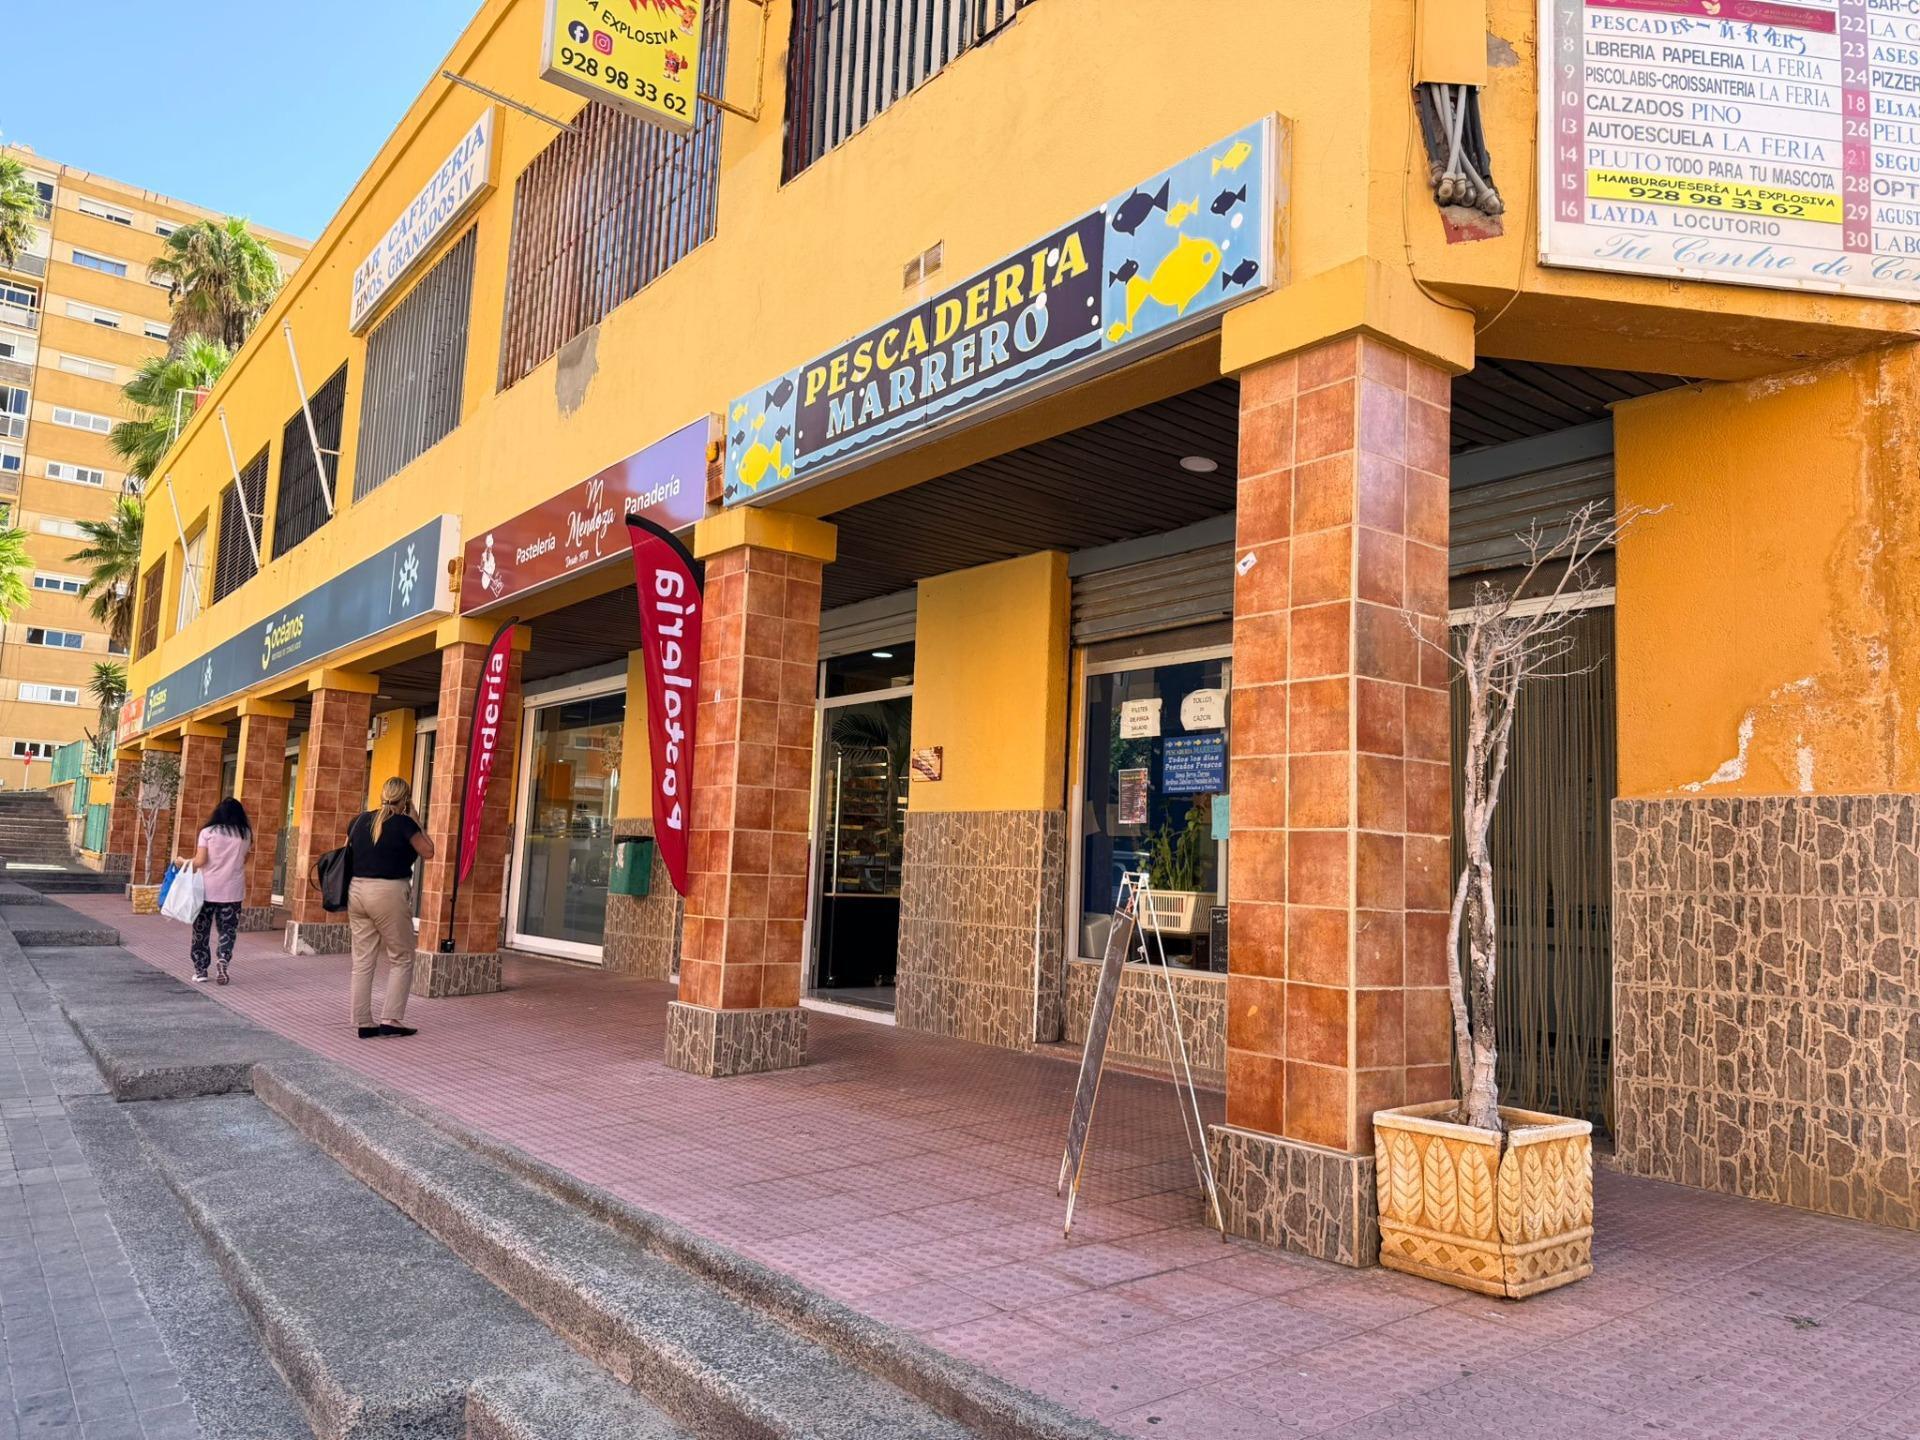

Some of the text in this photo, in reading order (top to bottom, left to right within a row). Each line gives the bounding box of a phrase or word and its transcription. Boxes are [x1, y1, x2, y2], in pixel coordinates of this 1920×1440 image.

[602, 10, 678, 45] EXPLOSIVA
[1562, 11, 1574, 26] 7
[1841, 16, 1866, 33] 22
[1870, 19, 1896, 38] LA
[1563, 38, 1574, 53] 8
[1843, 41, 1865, 58] 23
[1564, 65, 1575, 79] 9
[1586, 40, 1823, 80] LIBRERIA PAPELERIA LA FERIA
[561, 47, 687, 115] 928 98 33 62
[1844, 68, 1867, 84] 24
[1561, 91, 1578, 107] 10
[1760, 83, 1779, 102] LA
[1786, 86, 1830, 108] FERIA
[1847, 94, 1866, 112] 18
[1586, 94, 1741, 125] CALZADOS PINO
[1562, 118, 1577, 134] 13
[1846, 121, 1869, 137] 26
[1560, 146, 1578, 162] 14
[1587, 122, 1825, 162] AUTOESCUELA LA FERIA
[1589, 149, 1835, 190] PLUTO TODO PARA TU MASCOTA
[1847, 149, 1866, 166] 21
[1561, 173, 1577, 190] 15
[1597, 173, 1835, 207] HAMBURGUESERÍA LA EXPLOSIVA
[1845, 176, 1869, 193] 28
[354, 123, 485, 297] BAR CAFETERIA
[1561, 201, 1578, 217] 16
[1629, 187, 1805, 216] 928 98 33 62
[1846, 203, 1868, 220] 29
[387, 188, 455, 280] GRANADOS
[458, 164, 475, 202] IV
[1591, 204, 1781, 237] LAYDA LOCUTORIO
[1846, 231, 1868, 247] 30
[1594, 233, 1652, 260] Tu
[1812, 256, 1852, 277] de
[804, 231, 1089, 407] PESCADERIA
[826, 302, 1048, 439] MARRERO
[624, 474, 680, 515] Panadería
[565, 503, 616, 549] Mendoza
[515, 532, 556, 566] Pastelería
[271, 613, 304, 649] océanos
